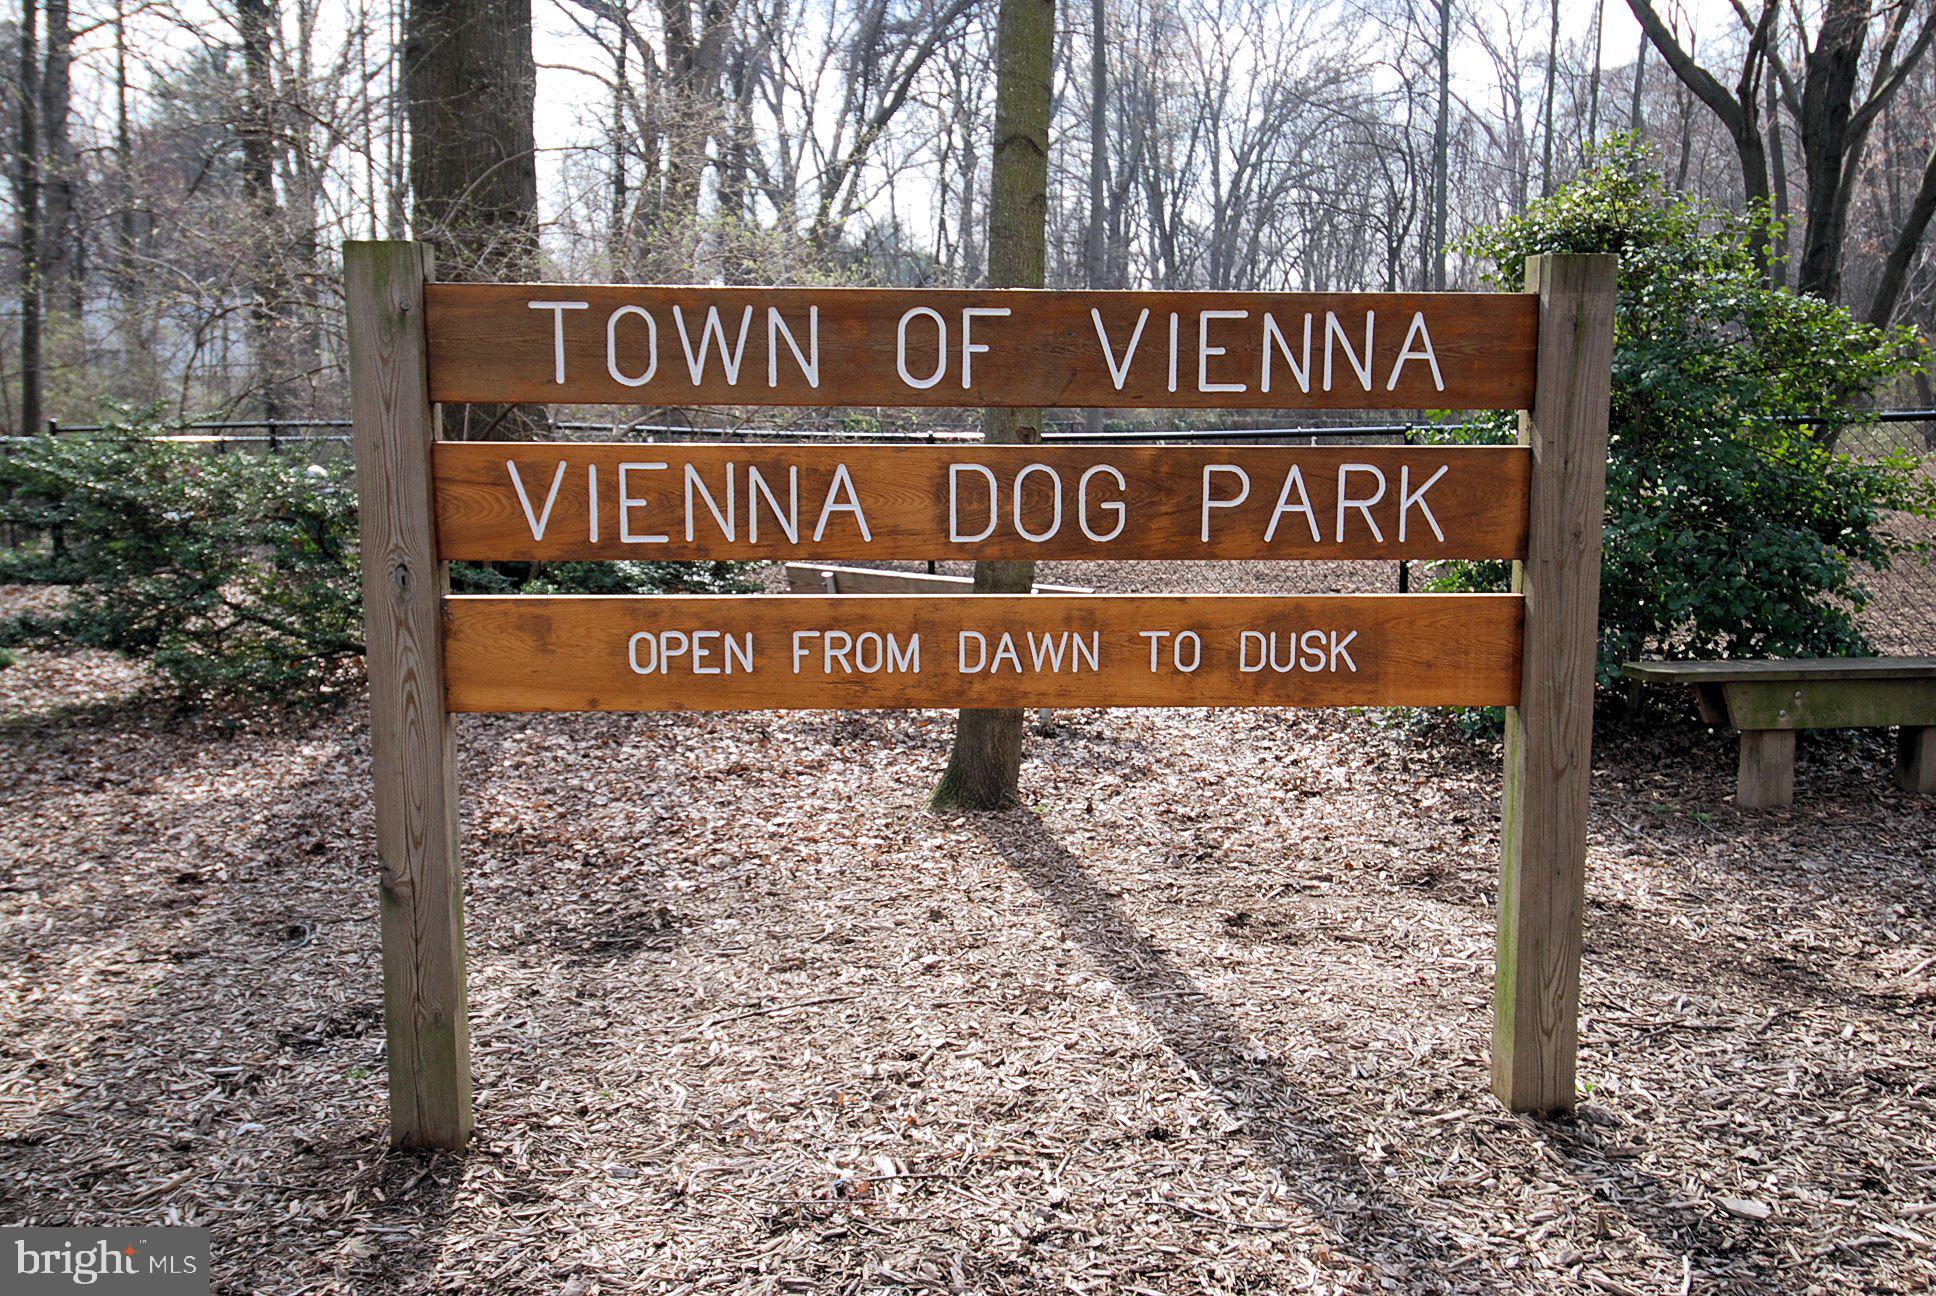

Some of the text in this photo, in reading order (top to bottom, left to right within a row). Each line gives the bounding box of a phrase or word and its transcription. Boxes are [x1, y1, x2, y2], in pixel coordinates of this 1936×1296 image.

[527, 300, 1445, 394] TOWN OF VIENNA
[506, 459, 1449, 545] VIENNA DOG PARK
[628, 629, 1358, 675] OPEN FROM DAWN TO DUSK
